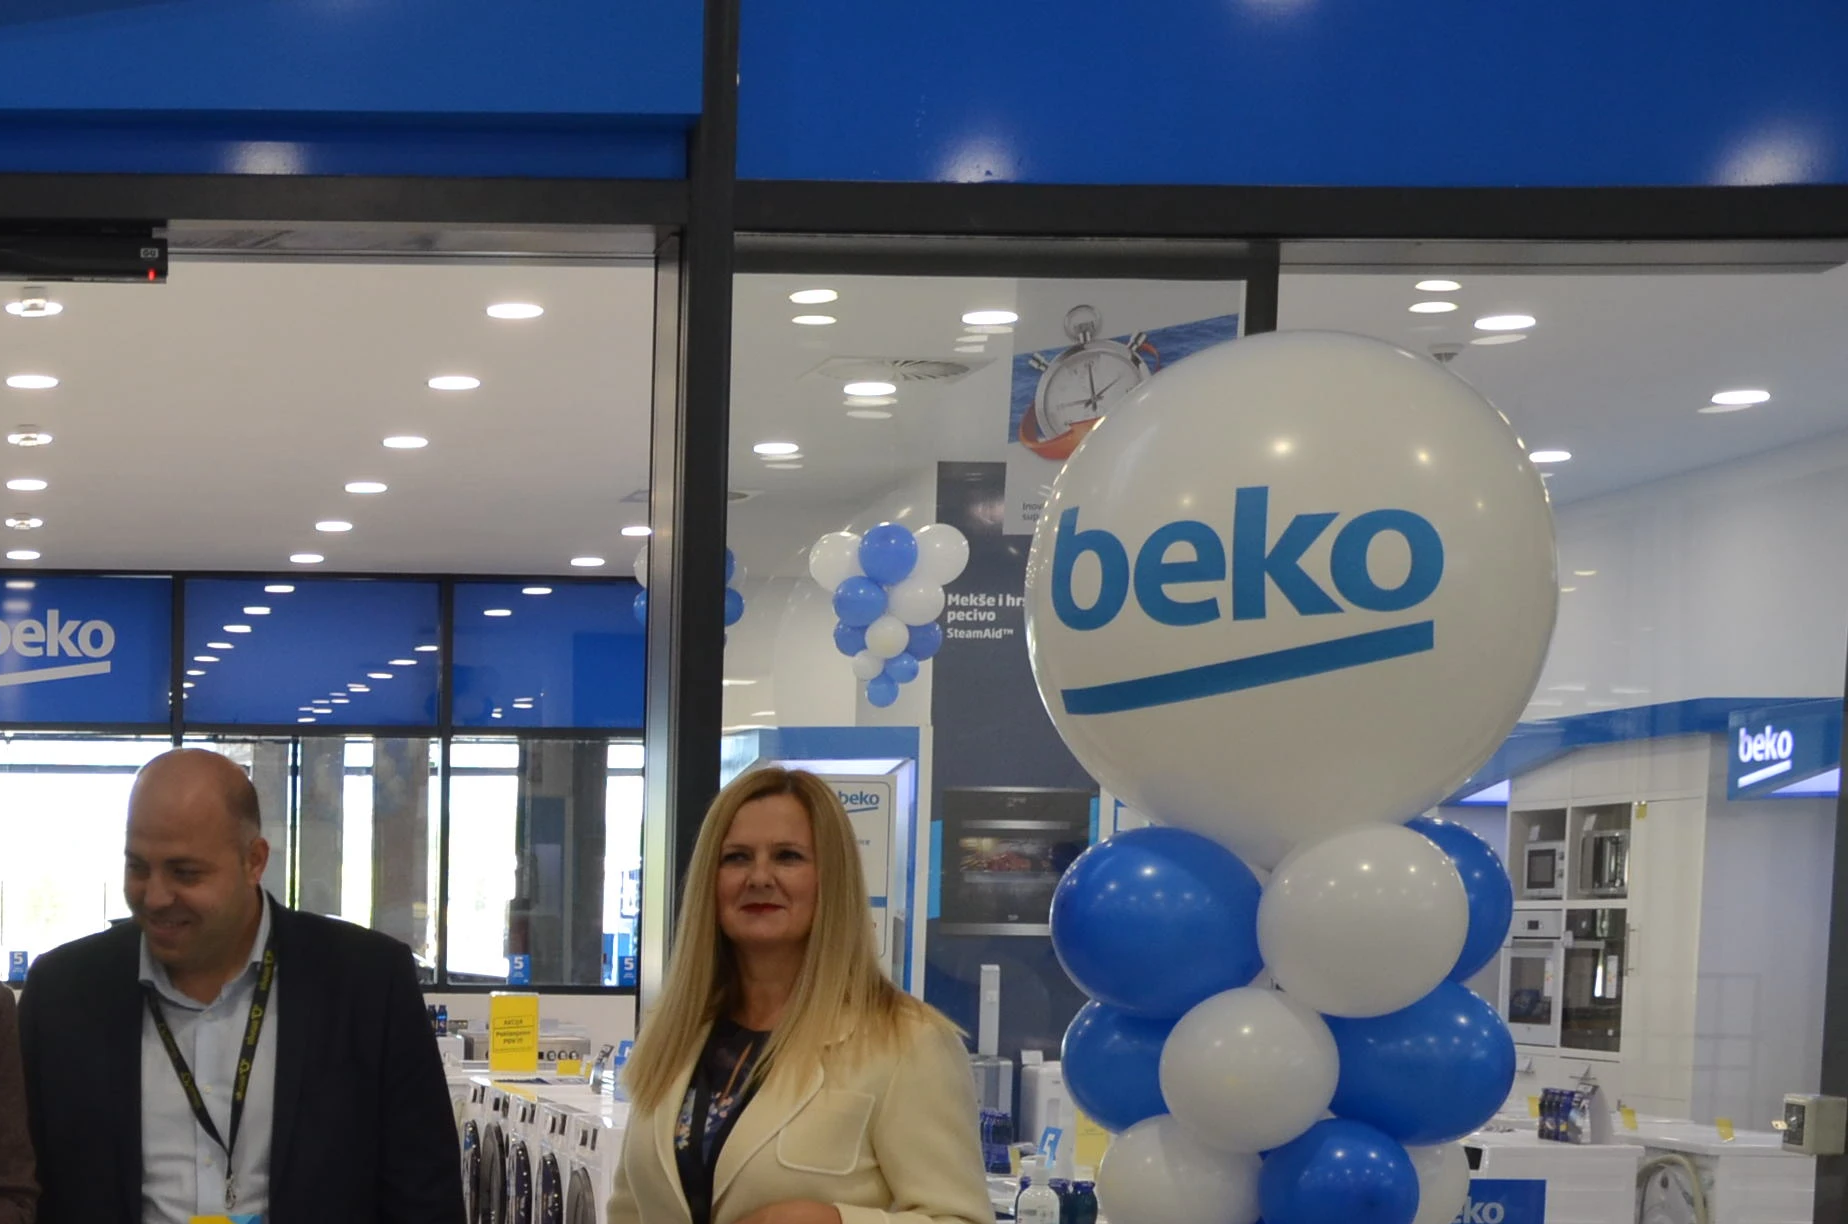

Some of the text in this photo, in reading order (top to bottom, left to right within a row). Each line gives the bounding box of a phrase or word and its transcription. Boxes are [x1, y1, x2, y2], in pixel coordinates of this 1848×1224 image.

[1022, 502, 1043, 510] Inov
[1022, 513, 1040, 521] sup
[1051, 486, 1444, 631] beko
[947, 593, 995, 606] Mekše
[1006, 594, 1025, 606] hr
[947, 609, 996, 623] pecivo
[1739, 724, 1793, 763] beko
[838, 791, 880, 806] beko
[13, 952, 24, 965] 5
[513, 956, 524, 969] 5
[623, 957, 634, 970] 5
